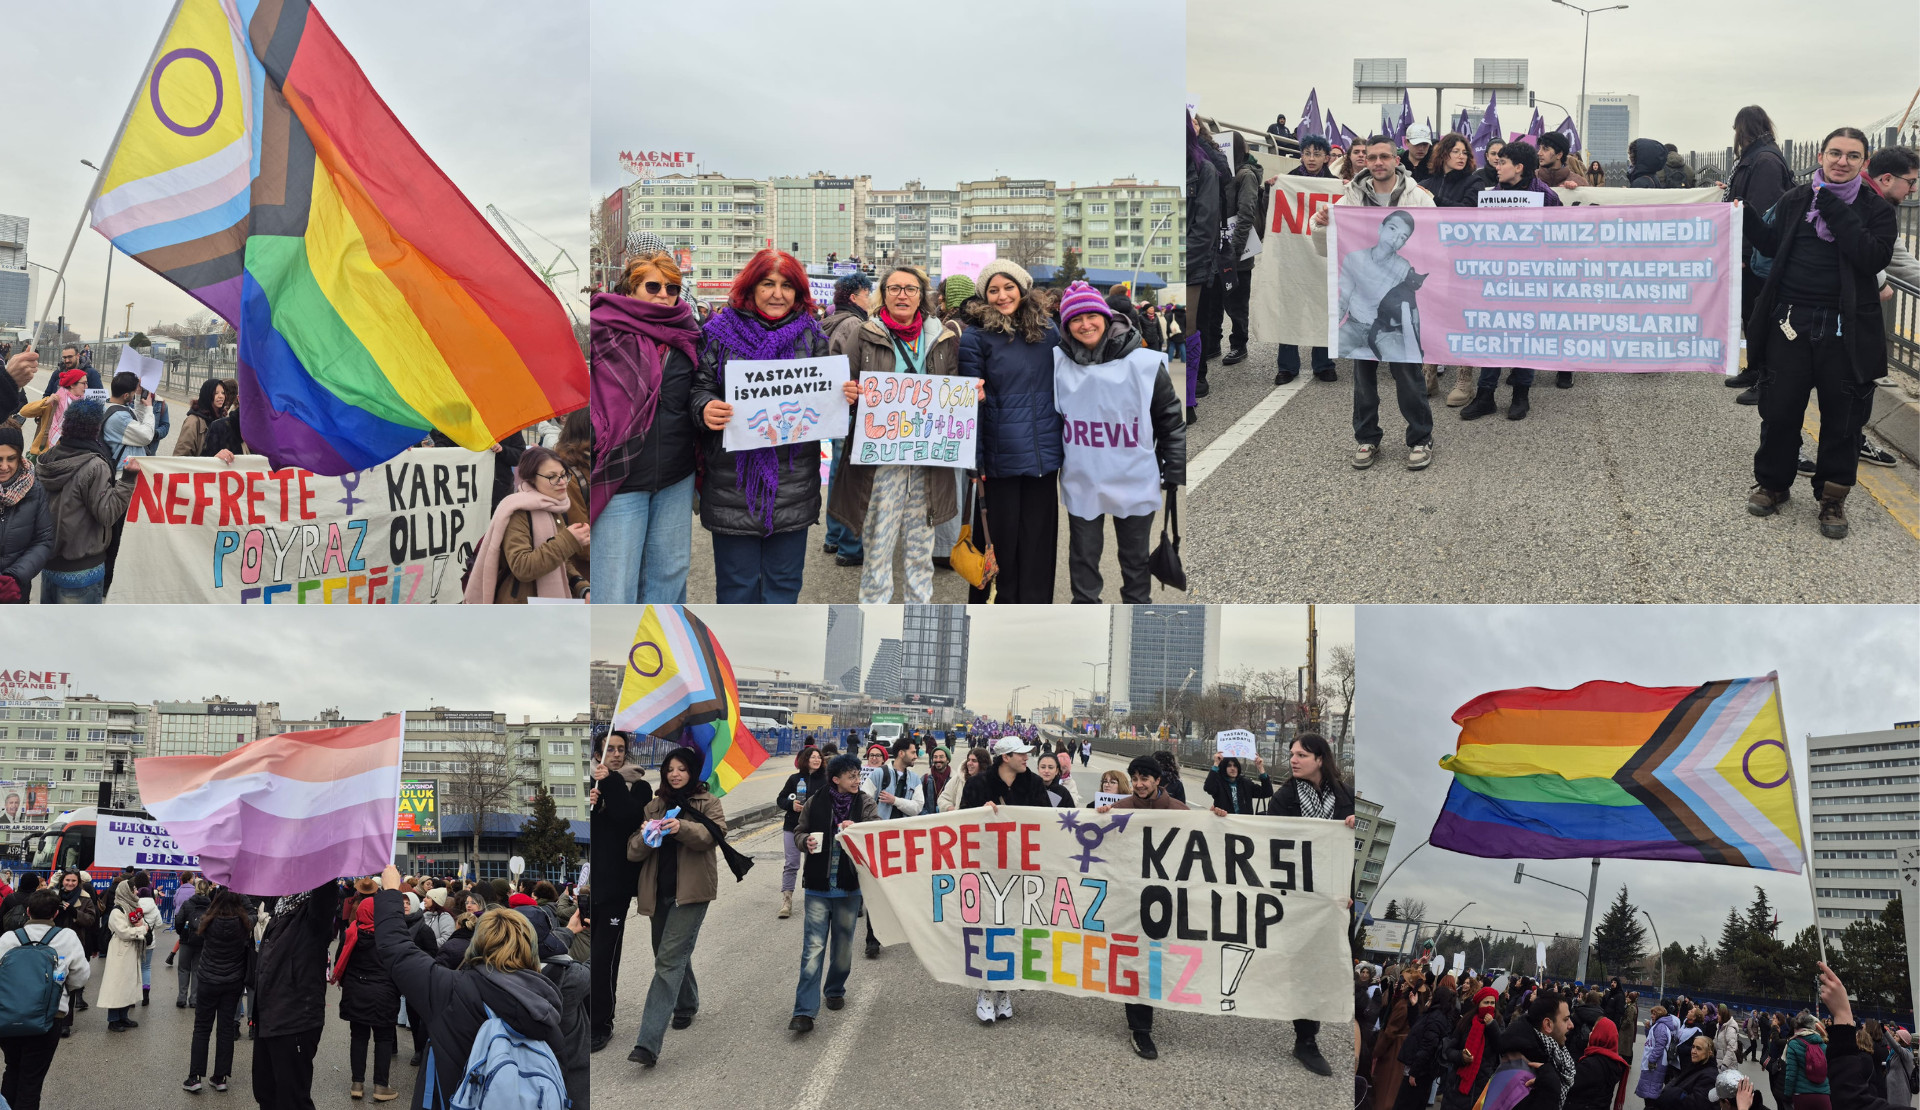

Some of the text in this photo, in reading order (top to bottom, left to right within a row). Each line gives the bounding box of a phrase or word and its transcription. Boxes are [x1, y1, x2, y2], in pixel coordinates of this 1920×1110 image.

[619, 150, 695, 163] MAGNET
[1480, 196, 1531, 204] AYRILMADIK,
[1600, 216, 1710, 242] DİNMEDİ!
[1455, 260, 1503, 276] UTKU
[1607, 257, 1713, 278] TALEPLERİ
[1483, 280, 1548, 297] ACİLEN
[1464, 311, 1698, 334] TRANS MAHPUSLARIN
[1447, 333, 1720, 359] TECRİTİNE SON VERİLSİN!
[745, 366, 823, 384] YASTAYIZ,
[734, 380, 832, 401] İSYANDAYIZ!
[860, 436, 961, 463] Burada
[126, 462, 478, 526] NEFRETE KARŞI
[213, 509, 466, 588] POYRAZ OLUP
[399, 790, 435, 798] ULUK
[114, 821, 167, 835] HAKLAR
[118, 836, 135, 846] VE
[842, 821, 1314, 896] NEFRETE KARŞI
[931, 872, 1284, 949] POYRAZ OLUP
